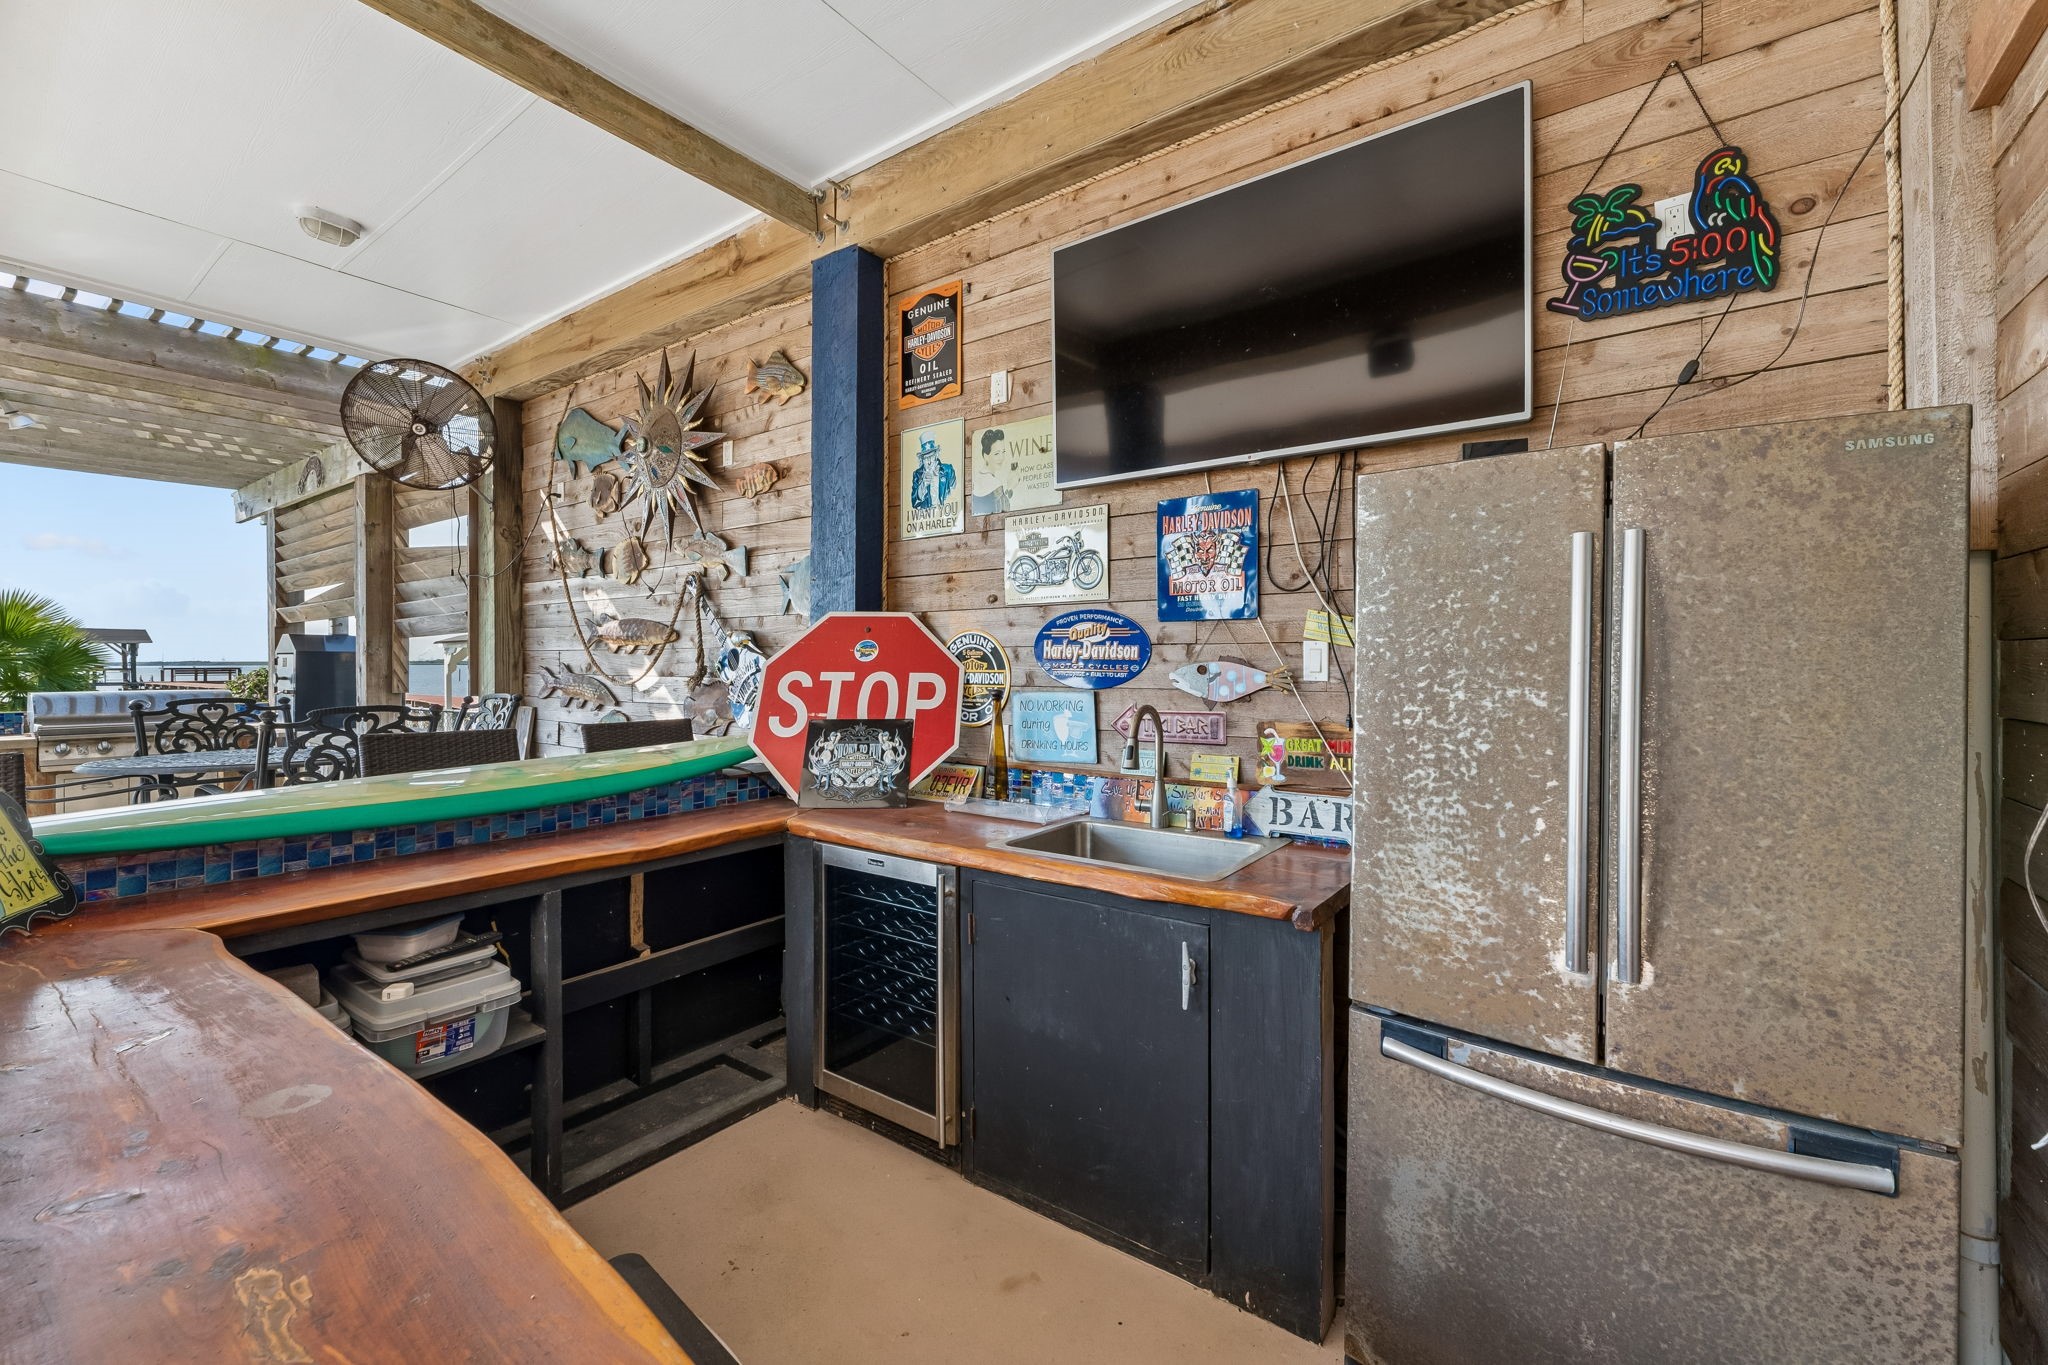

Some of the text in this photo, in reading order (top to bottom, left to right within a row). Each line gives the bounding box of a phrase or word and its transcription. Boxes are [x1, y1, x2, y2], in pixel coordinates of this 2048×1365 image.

[1621, 226, 1748, 278] It's 5:00
[1582, 266, 1755, 316] Somewhere
[907, 298, 950, 319] GENUINE
[907, 327, 951, 349] HARLEY-DAVIDSON
[919, 360, 939, 374] OIL
[905, 368, 953, 386] REFINERY SEALED
[1009, 434, 1052, 457] WINE
[1845, 433, 1935, 451] SAMSUNG
[1020, 462, 1054, 473] HOW CLASS
[1023, 472, 1042, 481] PEOPLE
[1026, 481, 1050, 490] WASTED
[906, 501, 959, 522] I WANT YOU
[906, 517, 957, 533] ON A HARLEY
[1162, 508, 1252, 535] HARLEY-DAVIDSON
[1172, 578, 1243, 594] MOTOR OIL
[1056, 613, 1124, 626] PROVEN PERFORMANCE
[1318, 622, 1346, 635] Wecome
[1069, 622, 1108, 640] Quality
[949, 634, 995, 653] GENUINE
[1043, 639, 1140, 664] Harley-Davidson
[964, 660, 984, 671] OTOR
[965, 672, 1004, 685] Y-DAVIDSON
[964, 685, 984, 696] YCLES
[768, 671, 947, 738] STOP
[1019, 700, 1034, 712] NO
[1021, 718, 1051, 732] during
[1175, 716, 1210, 735] BAR
[1060, 740, 1089, 752] HOURS
[1285, 737, 1352, 754] GREAT MIN
[1287, 755, 1352, 771] DRINK ALI
[1268, 796, 1353, 832] BAR
[0, 844, 26, 870] the
[0, 867, 48, 902] Shots
